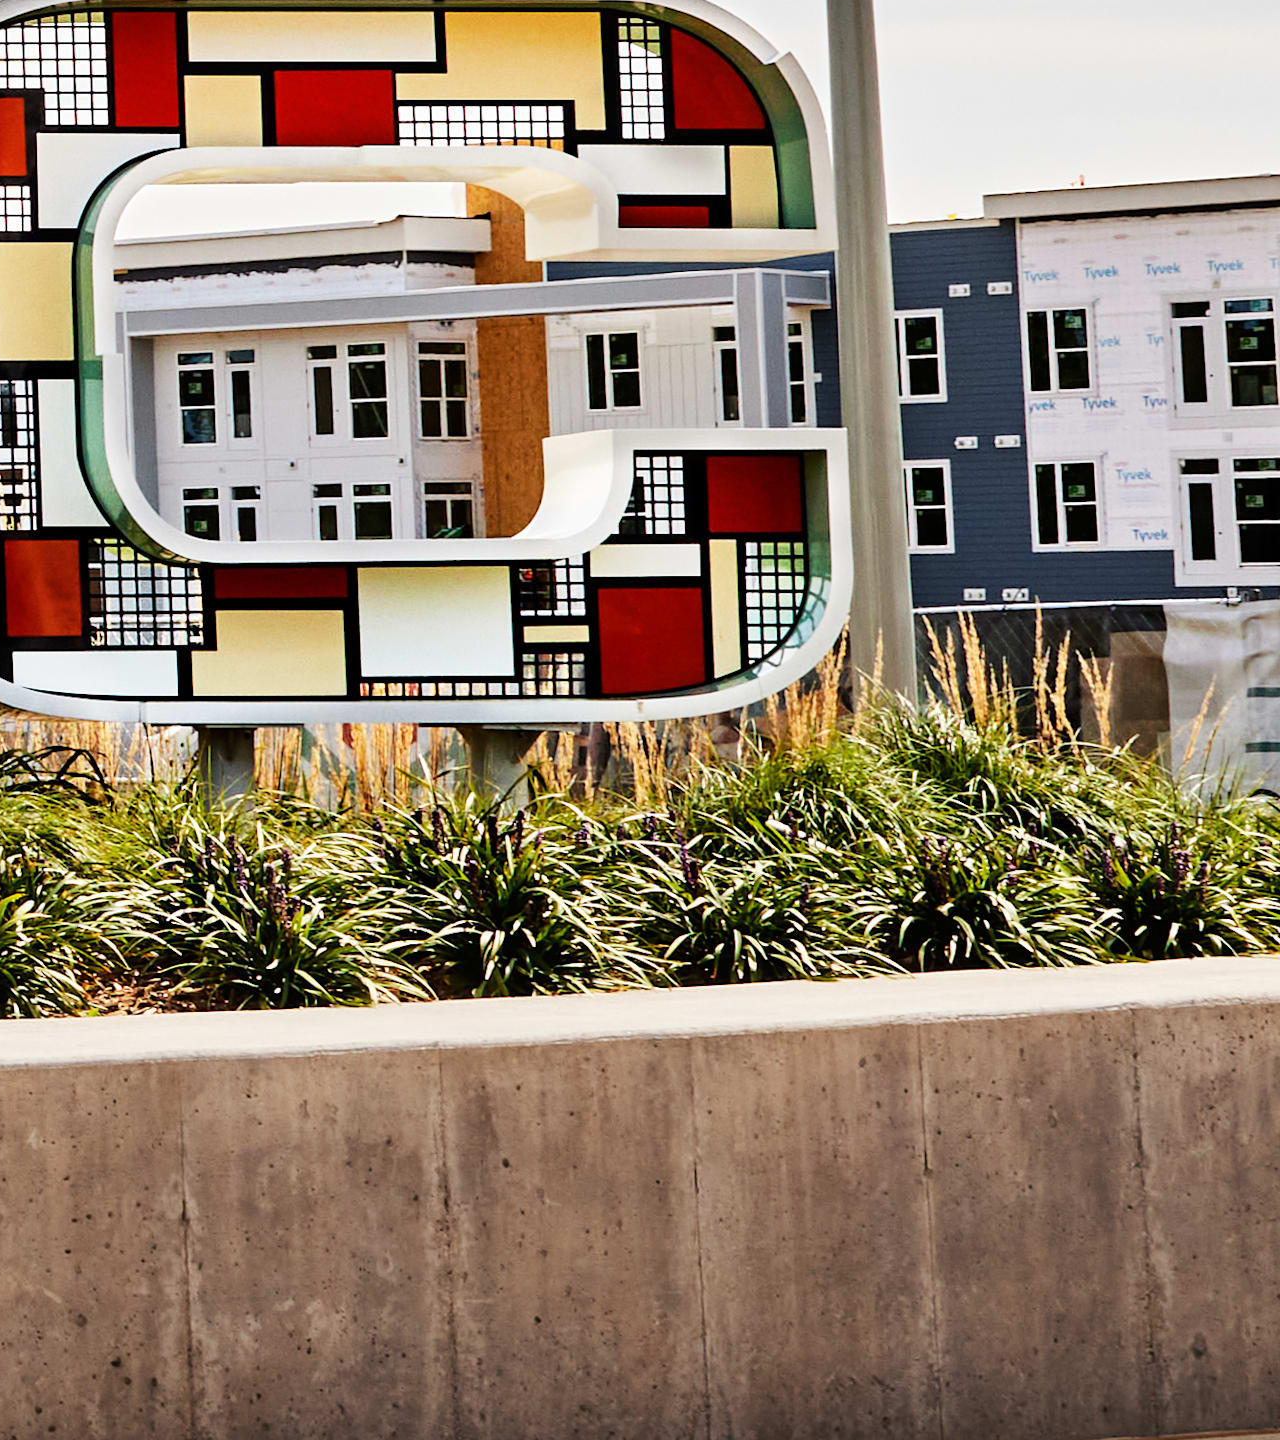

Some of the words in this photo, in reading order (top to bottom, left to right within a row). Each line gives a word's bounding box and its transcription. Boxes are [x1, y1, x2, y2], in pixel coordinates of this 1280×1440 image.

[1023, 270, 1059, 283] Tyvek
[1083, 265, 1119, 280] Tyvek
[1145, 262, 1181, 276] Tyvek
[1207, 258, 1244, 275] Tyvek
[1099, 334, 1121, 348] vek
[1028, 398, 1057, 413] yvek
[1082, 395, 1116, 412] Tyvek
[1143, 394, 1168, 409] Tyv
[1115, 466, 1152, 484] Tyvek
[1133, 527, 1168, 542] Tyvek
